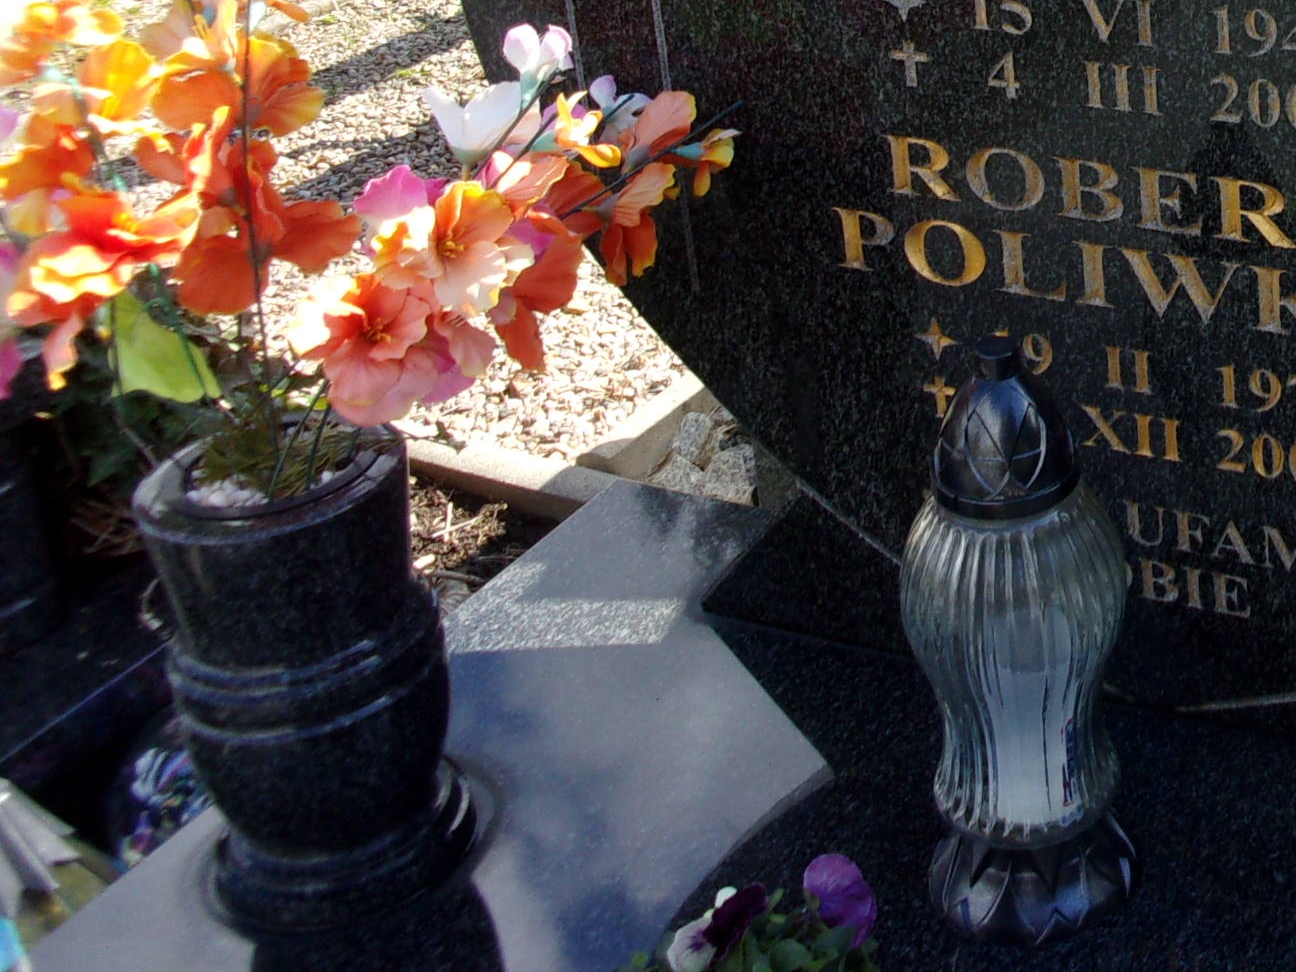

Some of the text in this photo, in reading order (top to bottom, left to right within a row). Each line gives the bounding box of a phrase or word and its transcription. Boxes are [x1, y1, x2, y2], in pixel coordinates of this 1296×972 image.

[987, 51, 1020, 99] 4
[1084, 61, 1163, 115] III
[994, 329, 1053, 375] 9
[1105, 346, 1153, 395] II
[1072, 399, 1184, 462] XII
[1125, 556, 1252, 619] BIE
